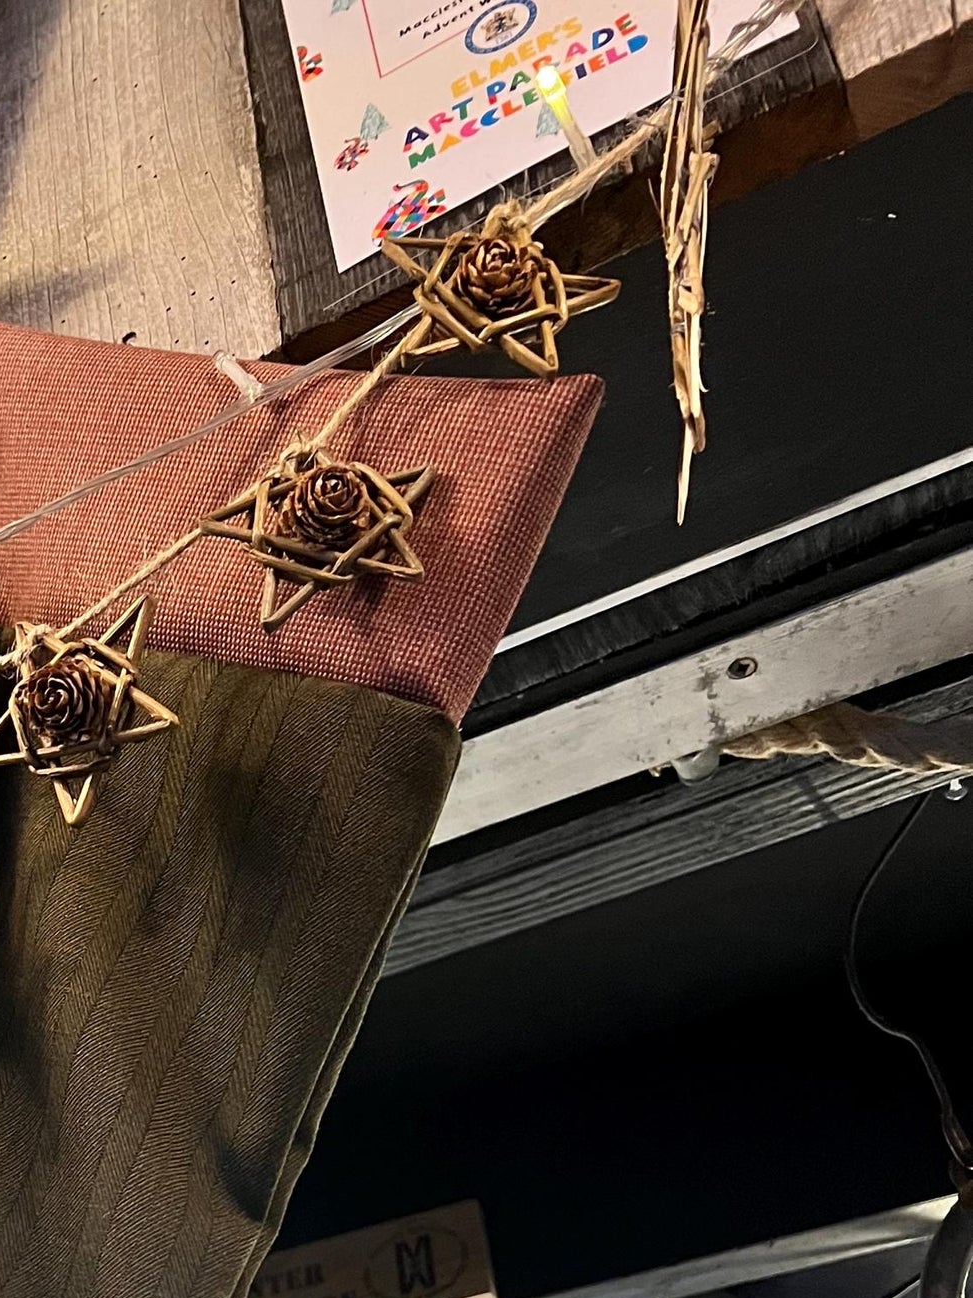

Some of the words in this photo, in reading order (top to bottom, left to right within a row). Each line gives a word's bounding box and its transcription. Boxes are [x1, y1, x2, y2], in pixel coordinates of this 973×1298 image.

[422, 6, 475, 40] Advent
[450, 16, 583, 98] ELMER'S
[402, 97, 474, 153] ART
[407, 34, 649, 169] MACCLEFIELD
